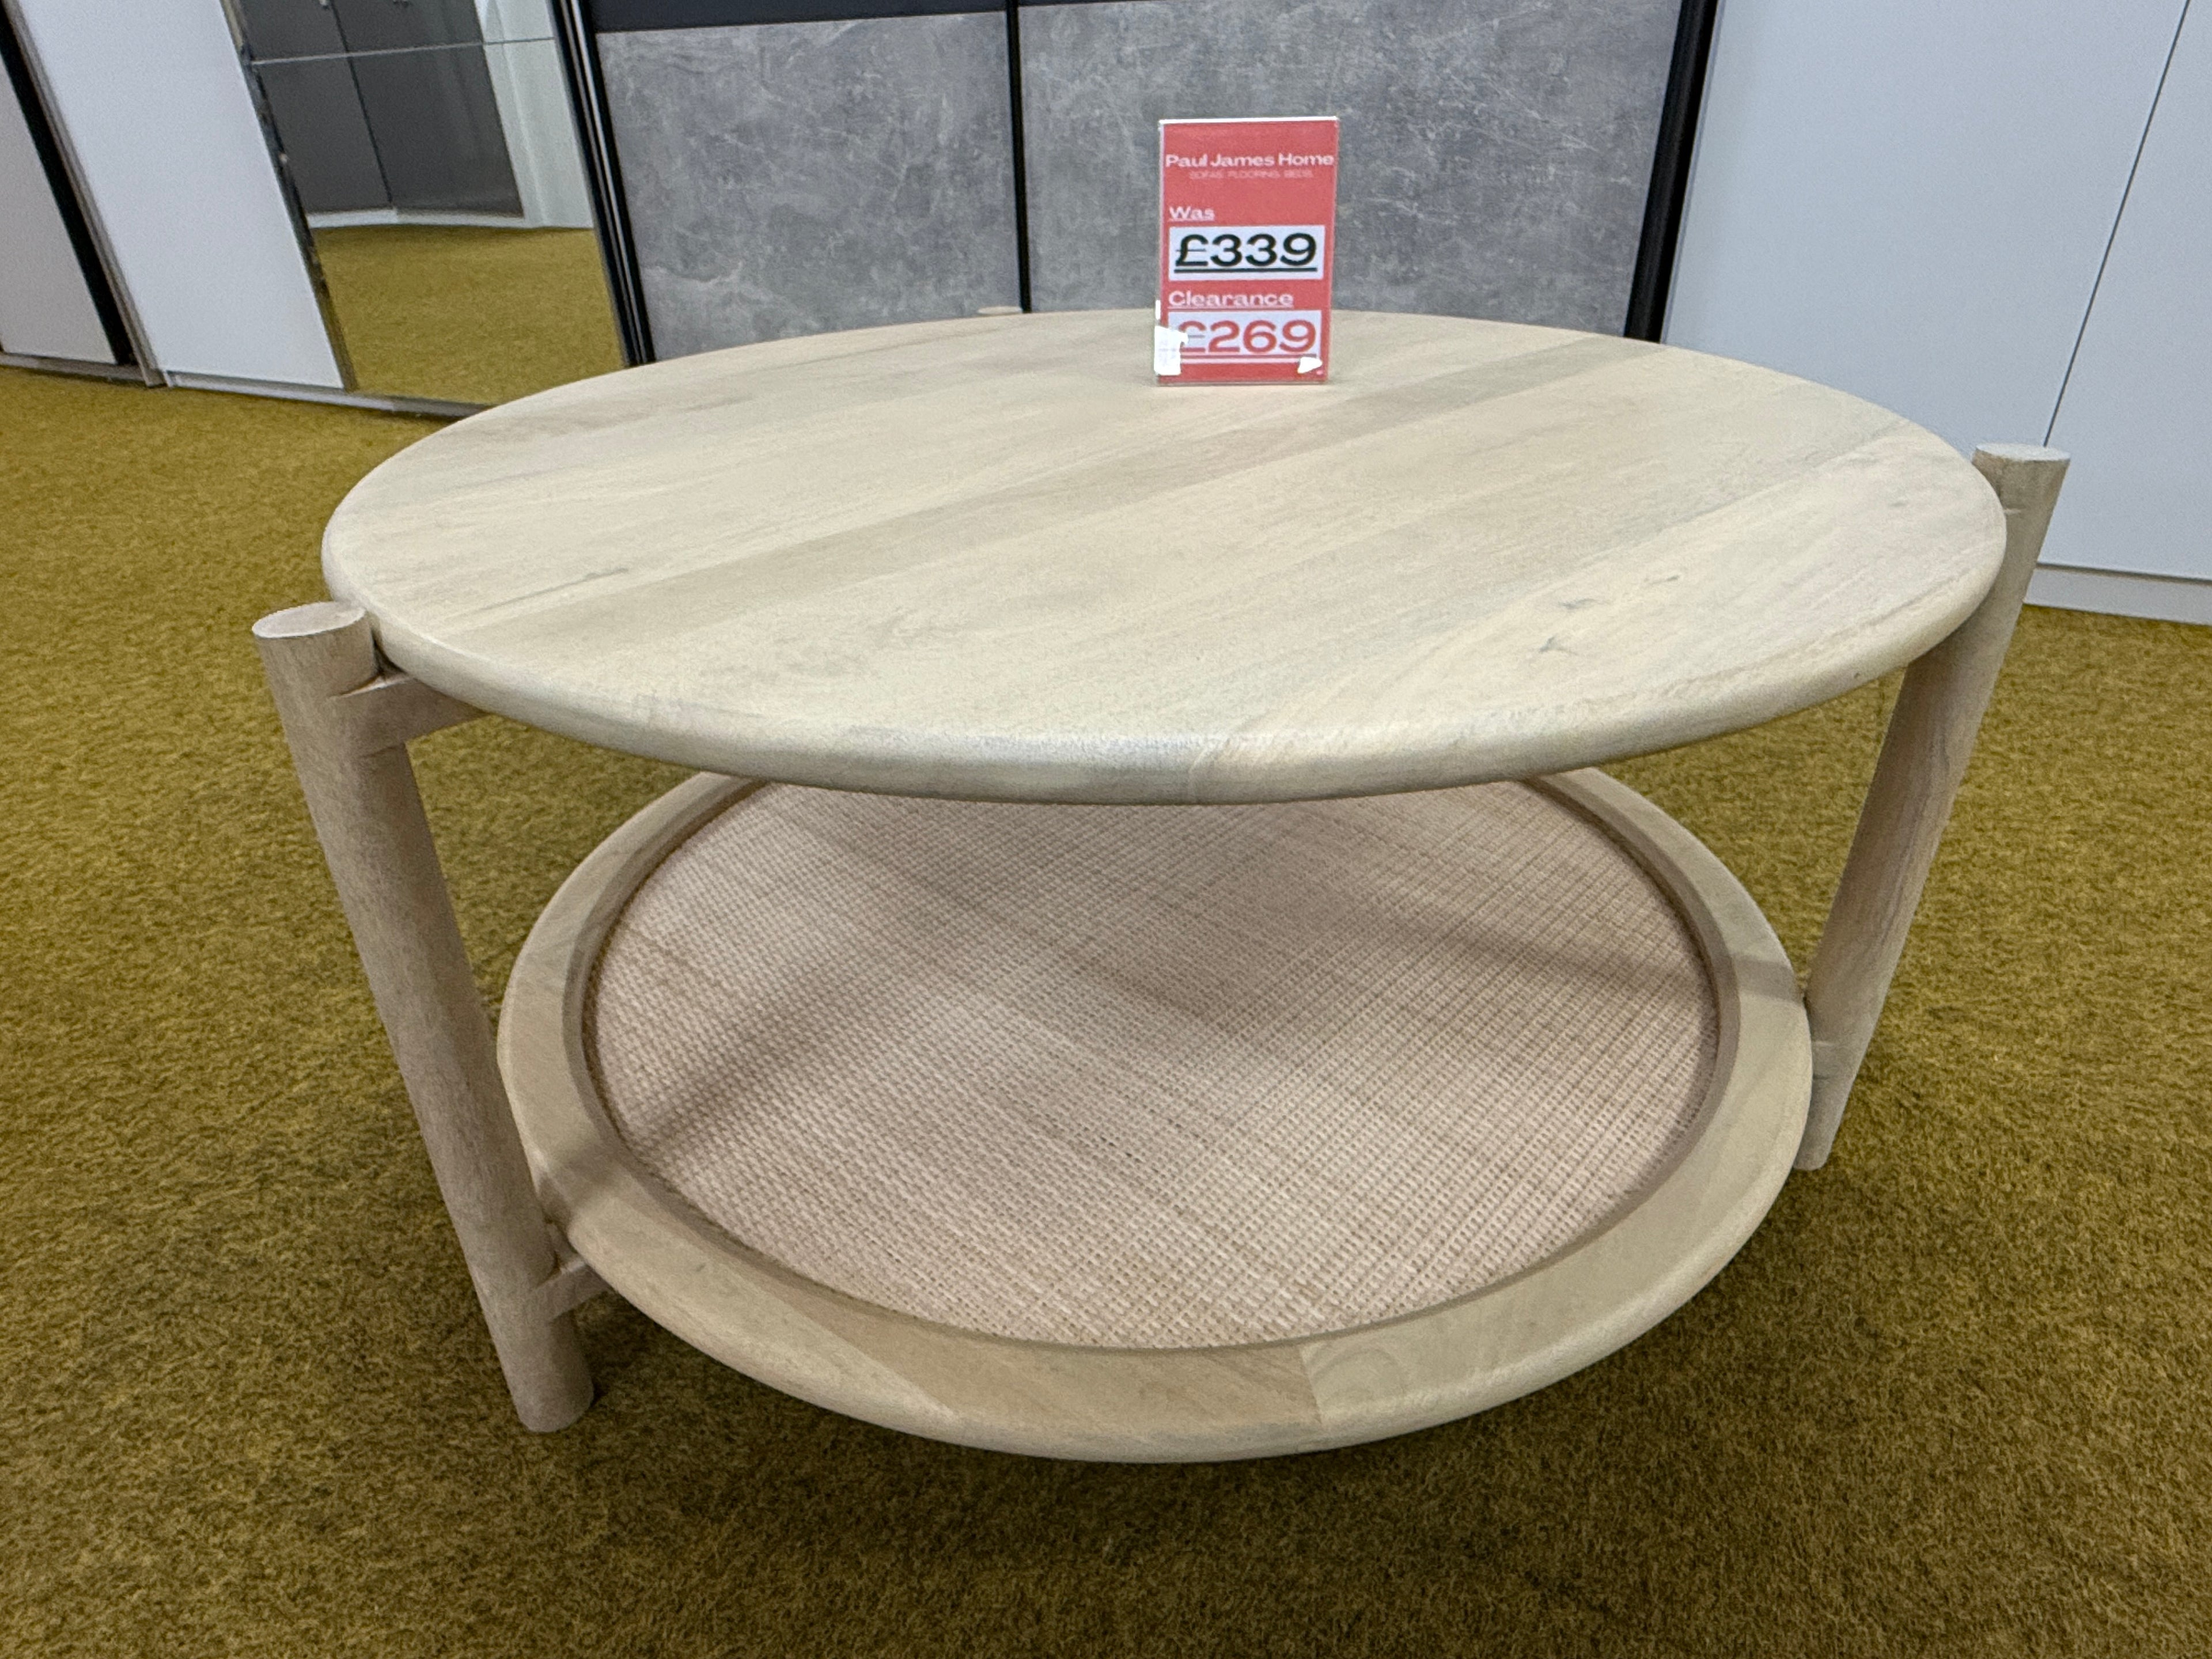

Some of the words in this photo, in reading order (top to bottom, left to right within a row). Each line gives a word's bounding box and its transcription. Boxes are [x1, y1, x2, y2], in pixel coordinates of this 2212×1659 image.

[1165, 154, 1208, 167] Paul
[1210, 153, 1275, 166] James
[1278, 152, 1335, 165] Home
[1169, 206, 1215, 220] Was
[1175, 233, 1317, 267] £339
[1168, 290, 1294, 306] Clearance
[1178, 320, 1317, 354] £269
